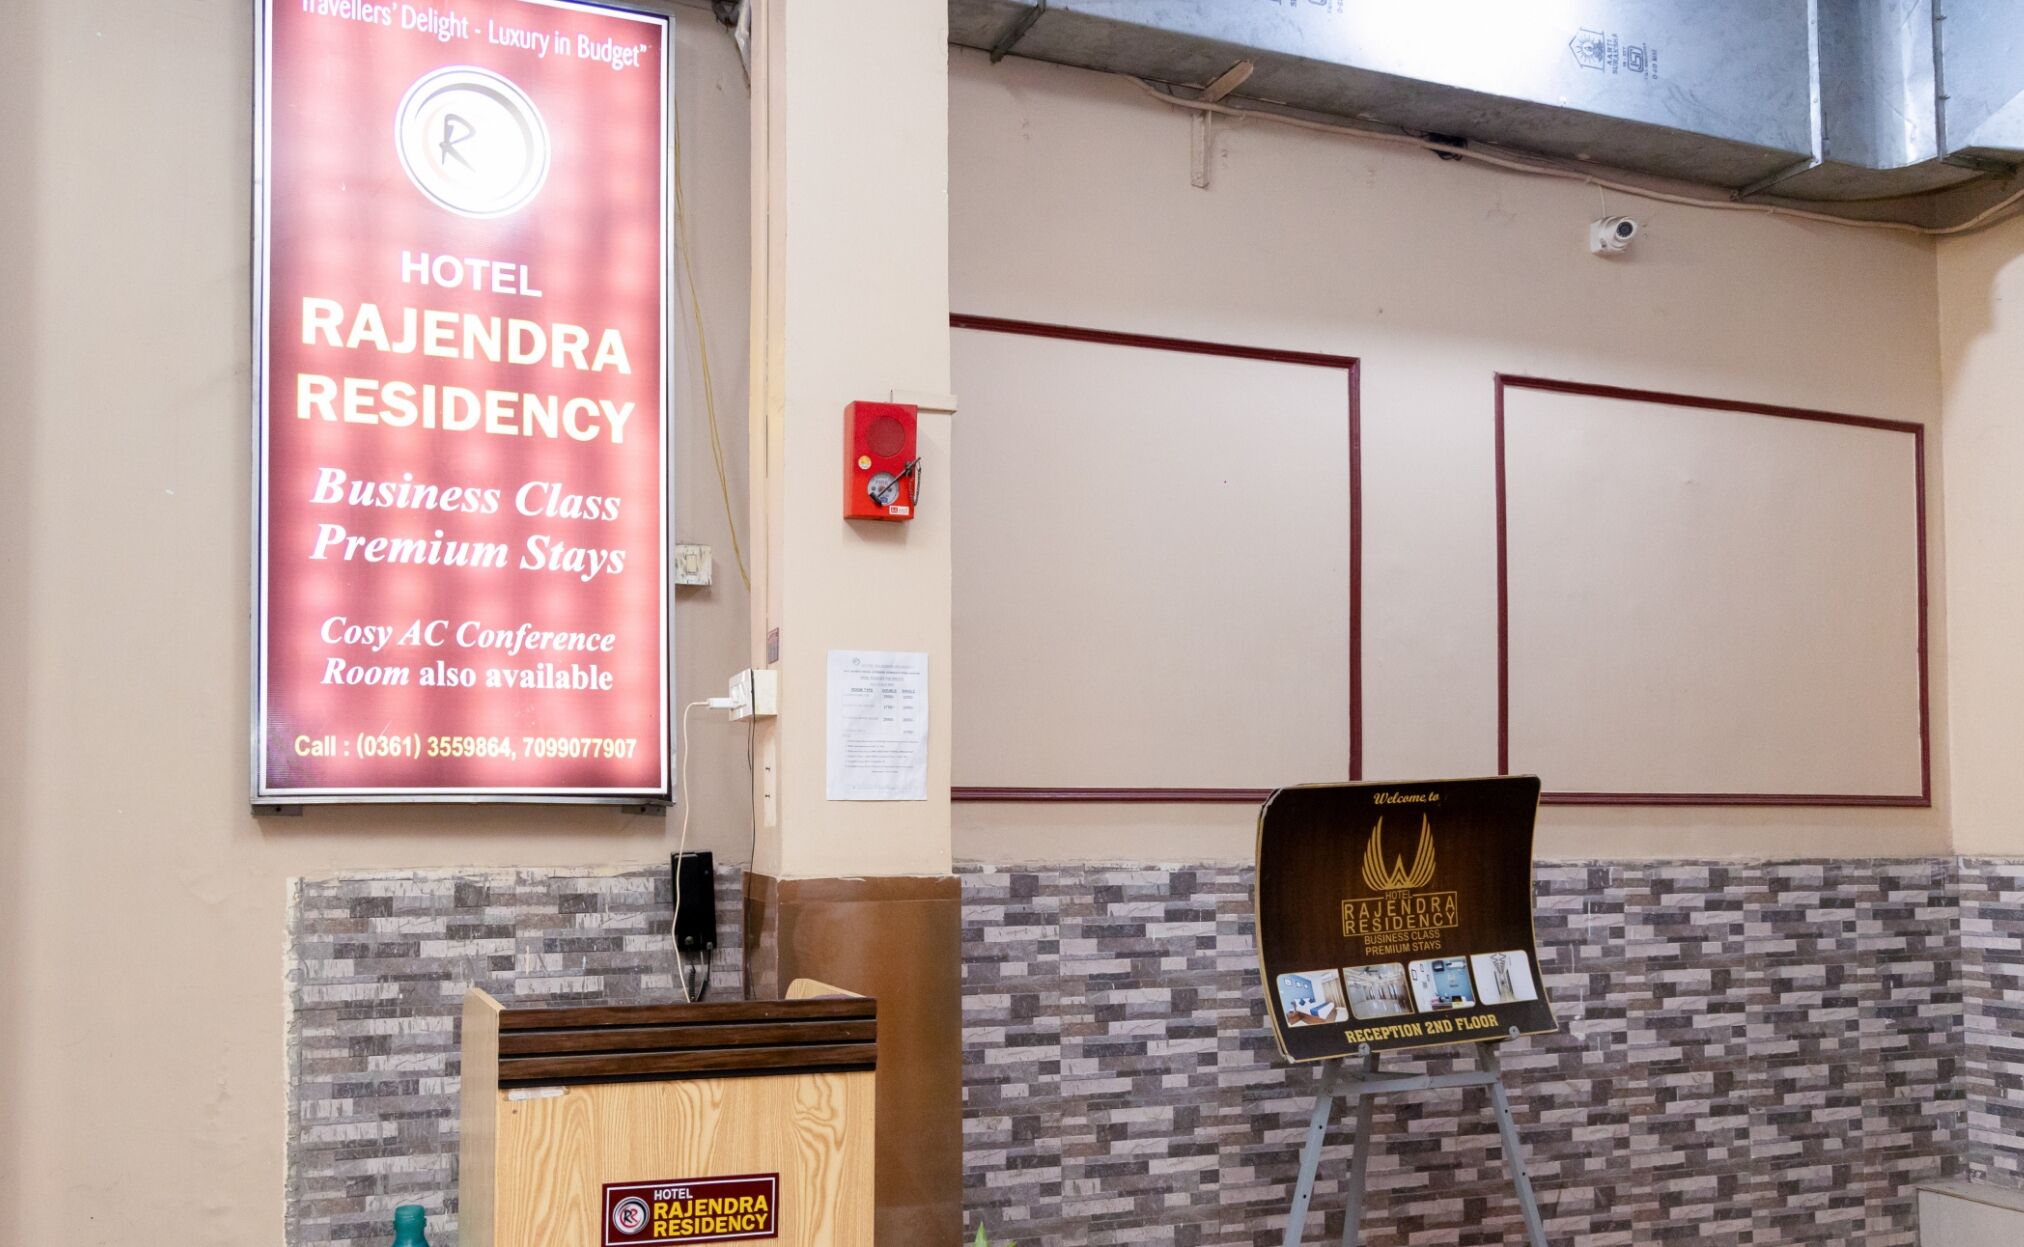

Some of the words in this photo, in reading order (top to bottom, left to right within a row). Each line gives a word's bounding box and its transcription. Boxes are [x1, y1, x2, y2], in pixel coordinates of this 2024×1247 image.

[400, 4, 470, 42] Delight
[488, 19, 550, 59] Luxury
[554, 31, 571, 56] in
[401, 250, 543, 298] HOTEL
[302, 296, 632, 375] RAJENDRA
[297, 373, 636, 444] RESIDENCY
[309, 467, 502, 514] Business
[516, 480, 622, 521] Class
[308, 523, 509, 568] Premium
[520, 534, 627, 582] Stays
[320, 616, 393, 652] Cosy
[398, 619, 449, 648] AC
[456, 620, 616, 656] Conference
[320, 657, 410, 686] Room
[419, 660, 477, 688] also
[485, 663, 614, 691] available
[294, 734, 336, 757] Call
[356, 732, 421, 759] (0361)
[427, 735, 517, 761] 3559864,
[522, 737, 637, 759] 7099077907
[1373, 792, 1427, 805] Welcome
[1428, 791, 1440, 802] to
[1344, 895, 1456, 920] RAJENDRA
[1385, 890, 1414, 900] HOTEL
[1345, 911, 1455, 935] RESIDENCY
[1364, 932, 1409, 945] BUSINESS
[1410, 929, 1440, 941] CLASS
[1365, 942, 1411, 956] PREMIUM
[1412, 940, 1442, 952] STAYS
[1344, 1022, 1423, 1043] RECEPTION
[1425, 1018, 1453, 1035] 2ND
[1455, 1014, 1499, 1031] FLOOR
[653, 1195, 768, 1220] RAJENDRA
[654, 1188, 693, 1200] HOTEL
[653, 1213, 768, 1237] RESIDENCY
